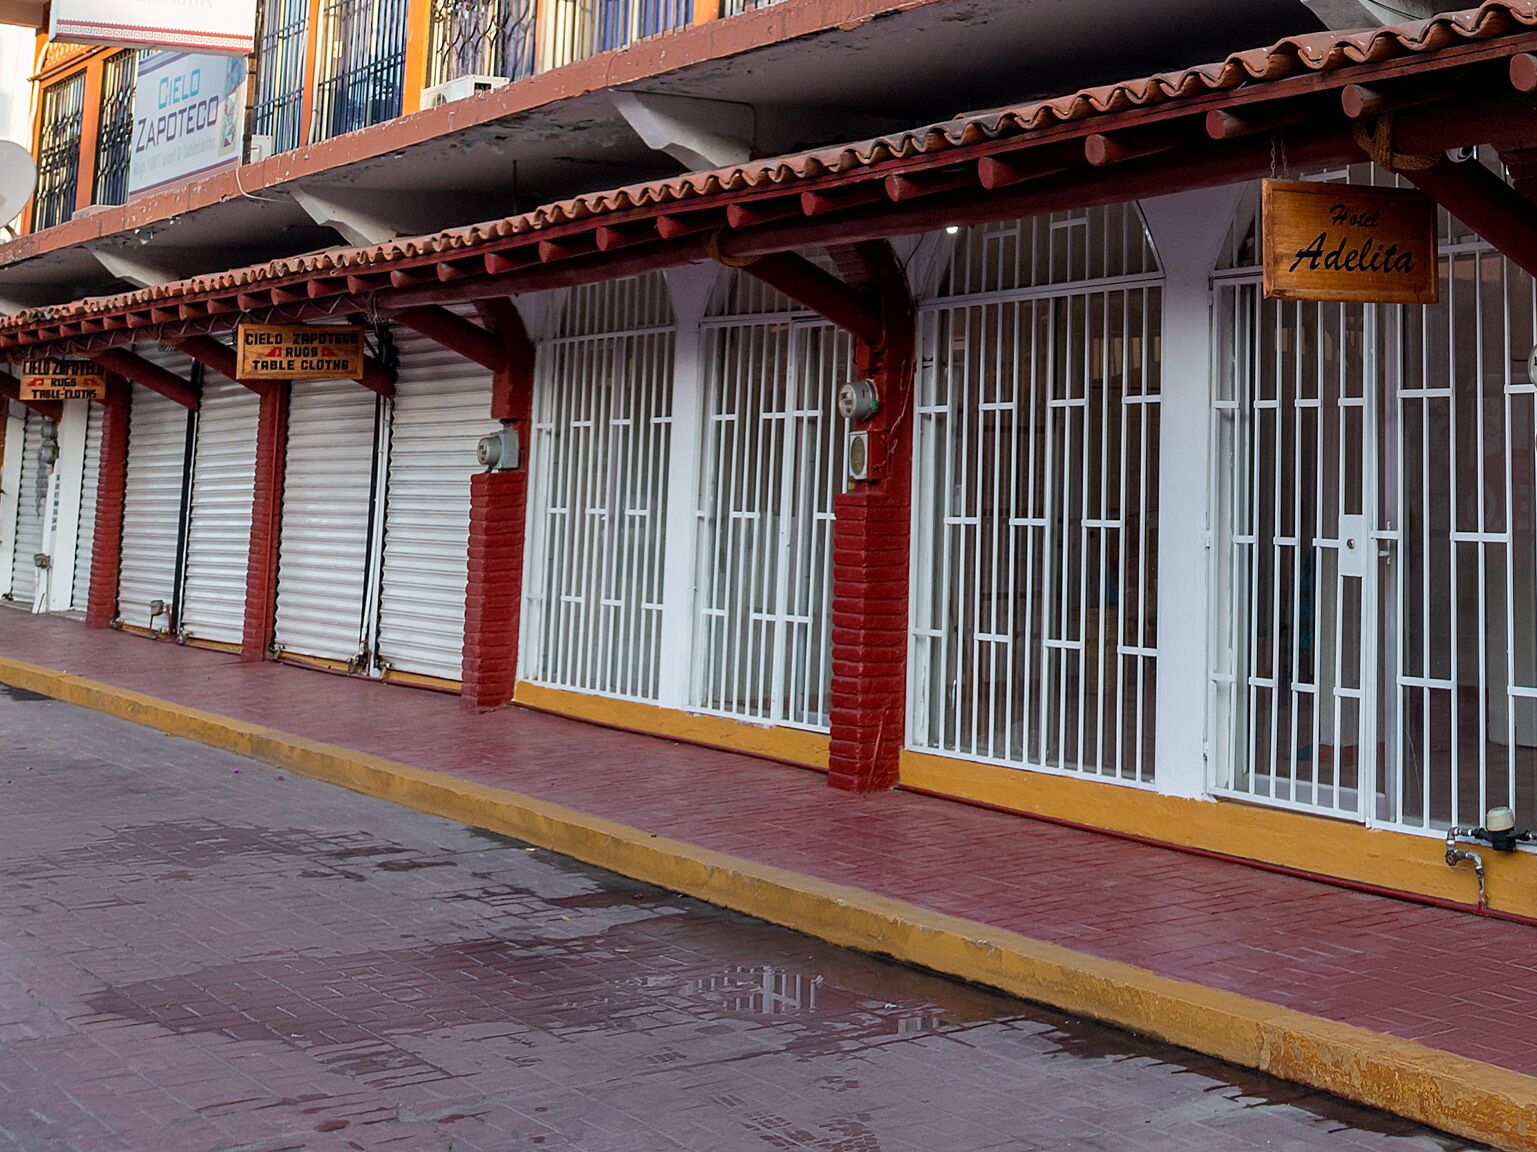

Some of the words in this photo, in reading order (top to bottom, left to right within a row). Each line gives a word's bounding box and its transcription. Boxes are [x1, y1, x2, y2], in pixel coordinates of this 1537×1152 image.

[158, 68, 200, 110] CIELO
[135, 95, 219, 153] ZAPOTECO
[1329, 204, 1379, 227] Hotel
[1289, 231, 1416, 274] Adelita
[246, 333, 282, 345] CIELO
[292, 333, 358, 345] ZAPOTECO
[285, 346, 318, 358] RUGS
[23, 359, 49, 375] CIELO
[252, 360, 294, 370] TABLE
[301, 360, 349, 370] CLOTHS
[50, 378, 77, 387] RUGS
